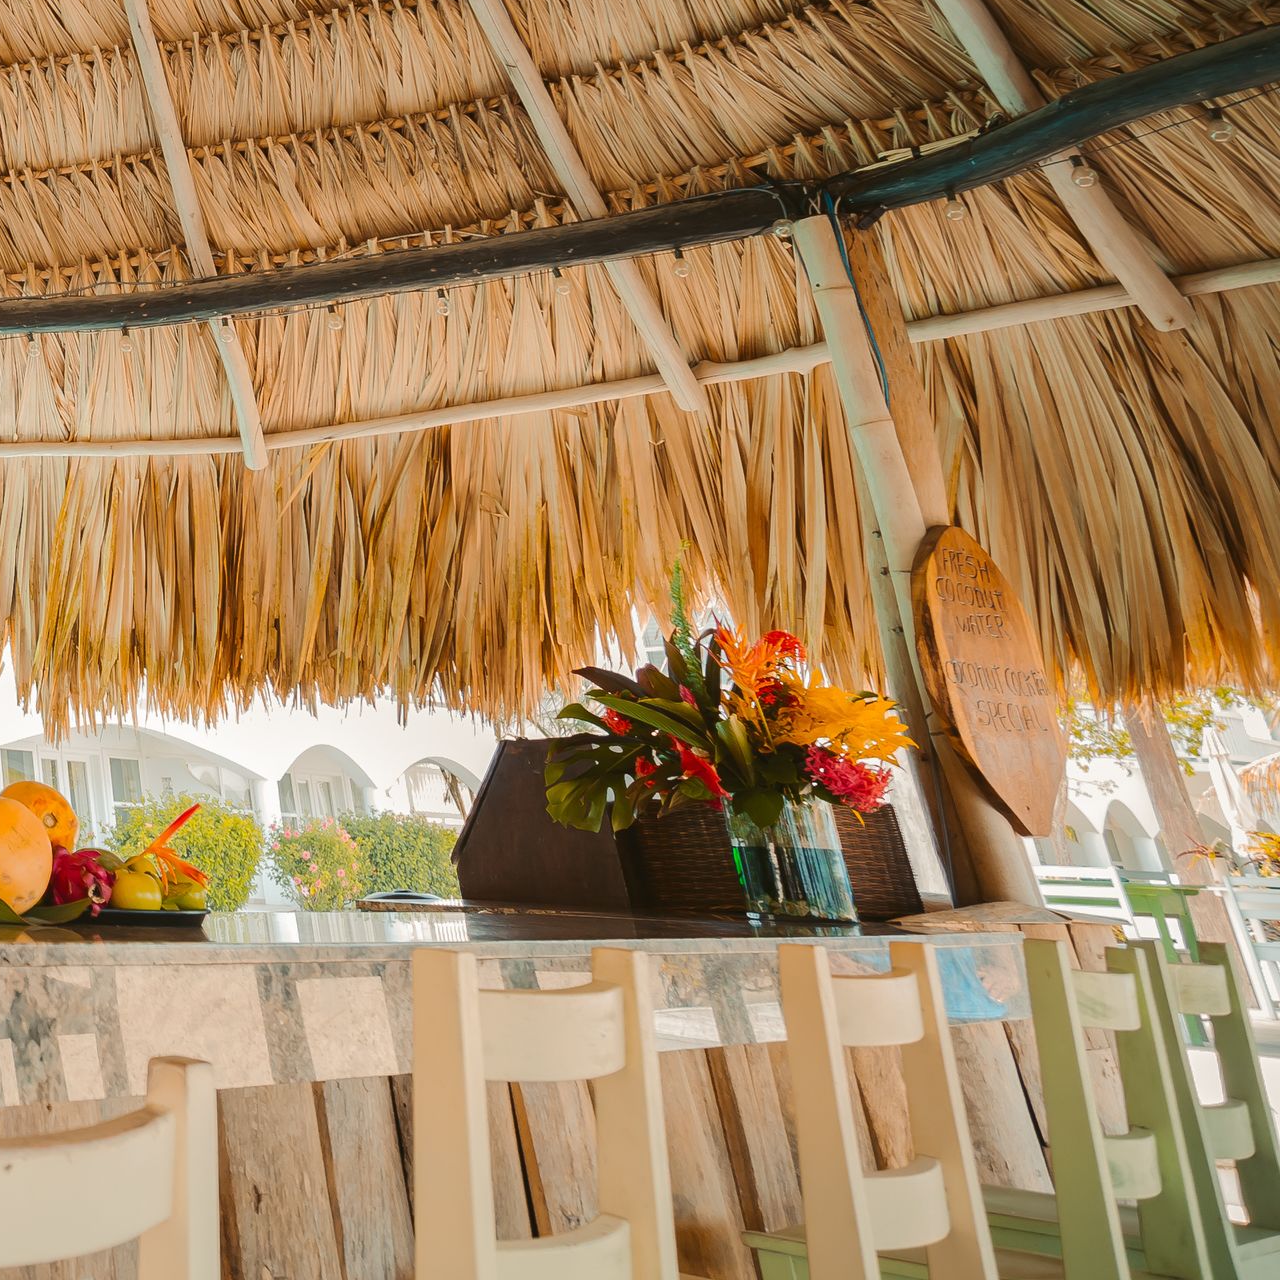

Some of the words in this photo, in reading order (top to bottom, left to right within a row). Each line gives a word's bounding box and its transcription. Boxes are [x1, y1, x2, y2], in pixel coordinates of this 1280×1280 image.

[942, 548, 991, 584] FRESH
[935, 576, 1005, 613] COCONUT
[955, 613, 1012, 641] WATER
